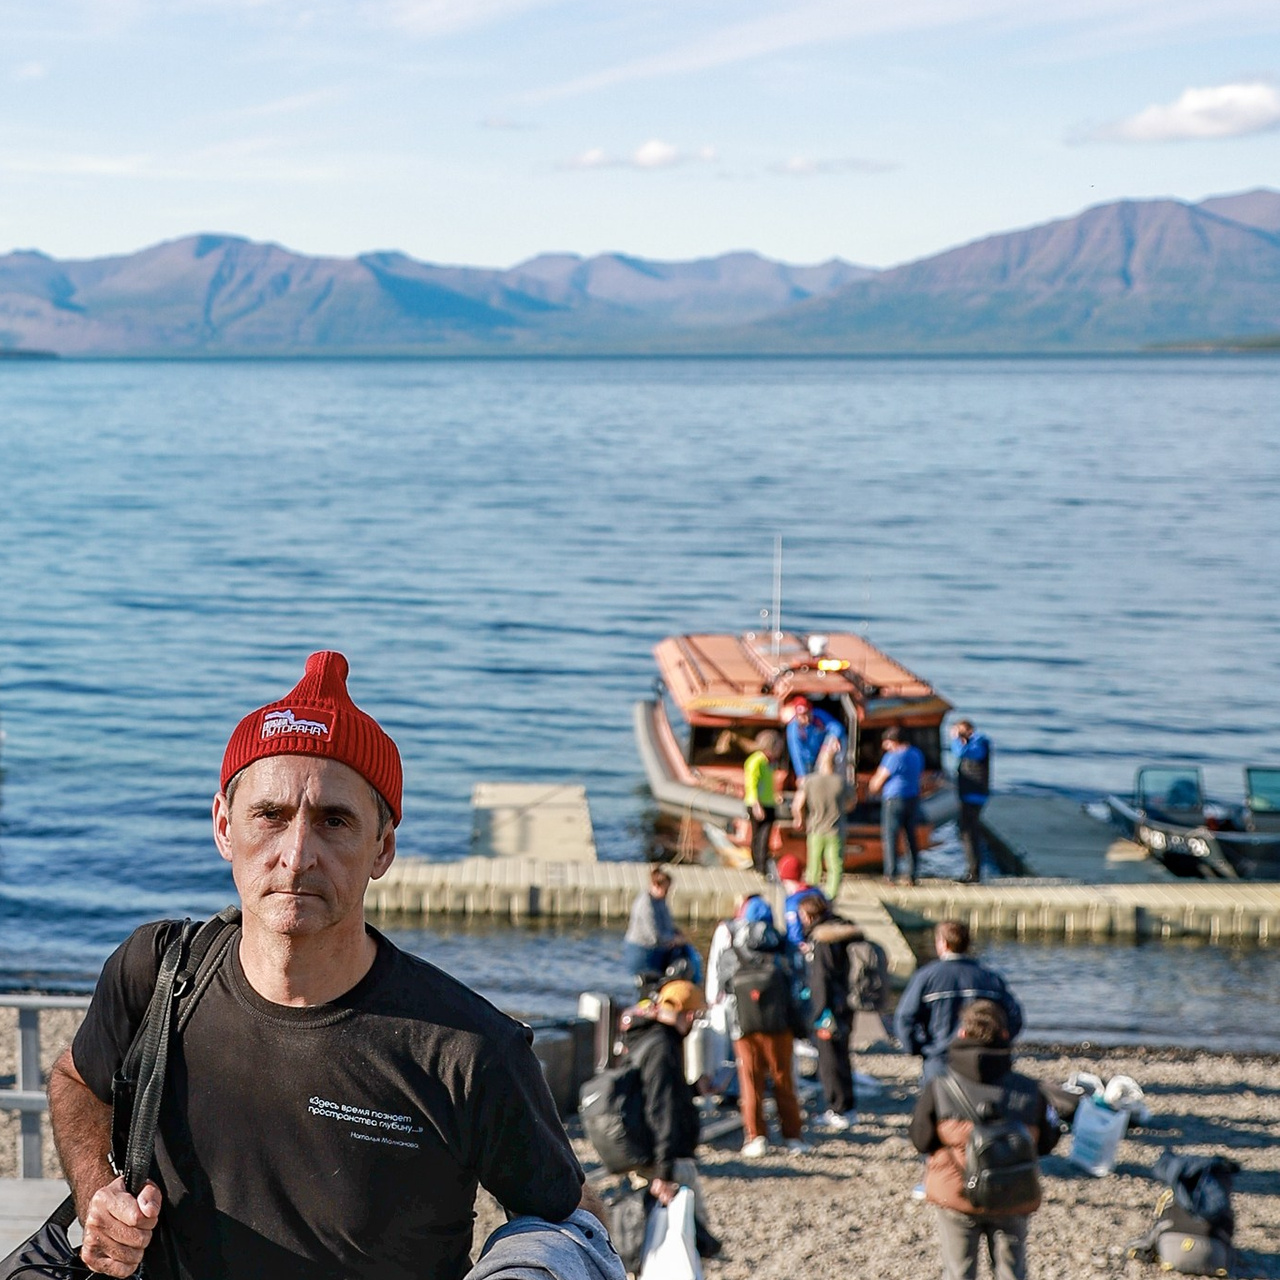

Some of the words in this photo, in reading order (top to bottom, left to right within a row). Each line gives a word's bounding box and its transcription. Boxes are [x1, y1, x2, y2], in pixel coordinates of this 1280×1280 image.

[341, 1104, 371, 1116] время
[371, 1110, 412, 1122] познает
[350, 1131, 380, 1142] Наталья
